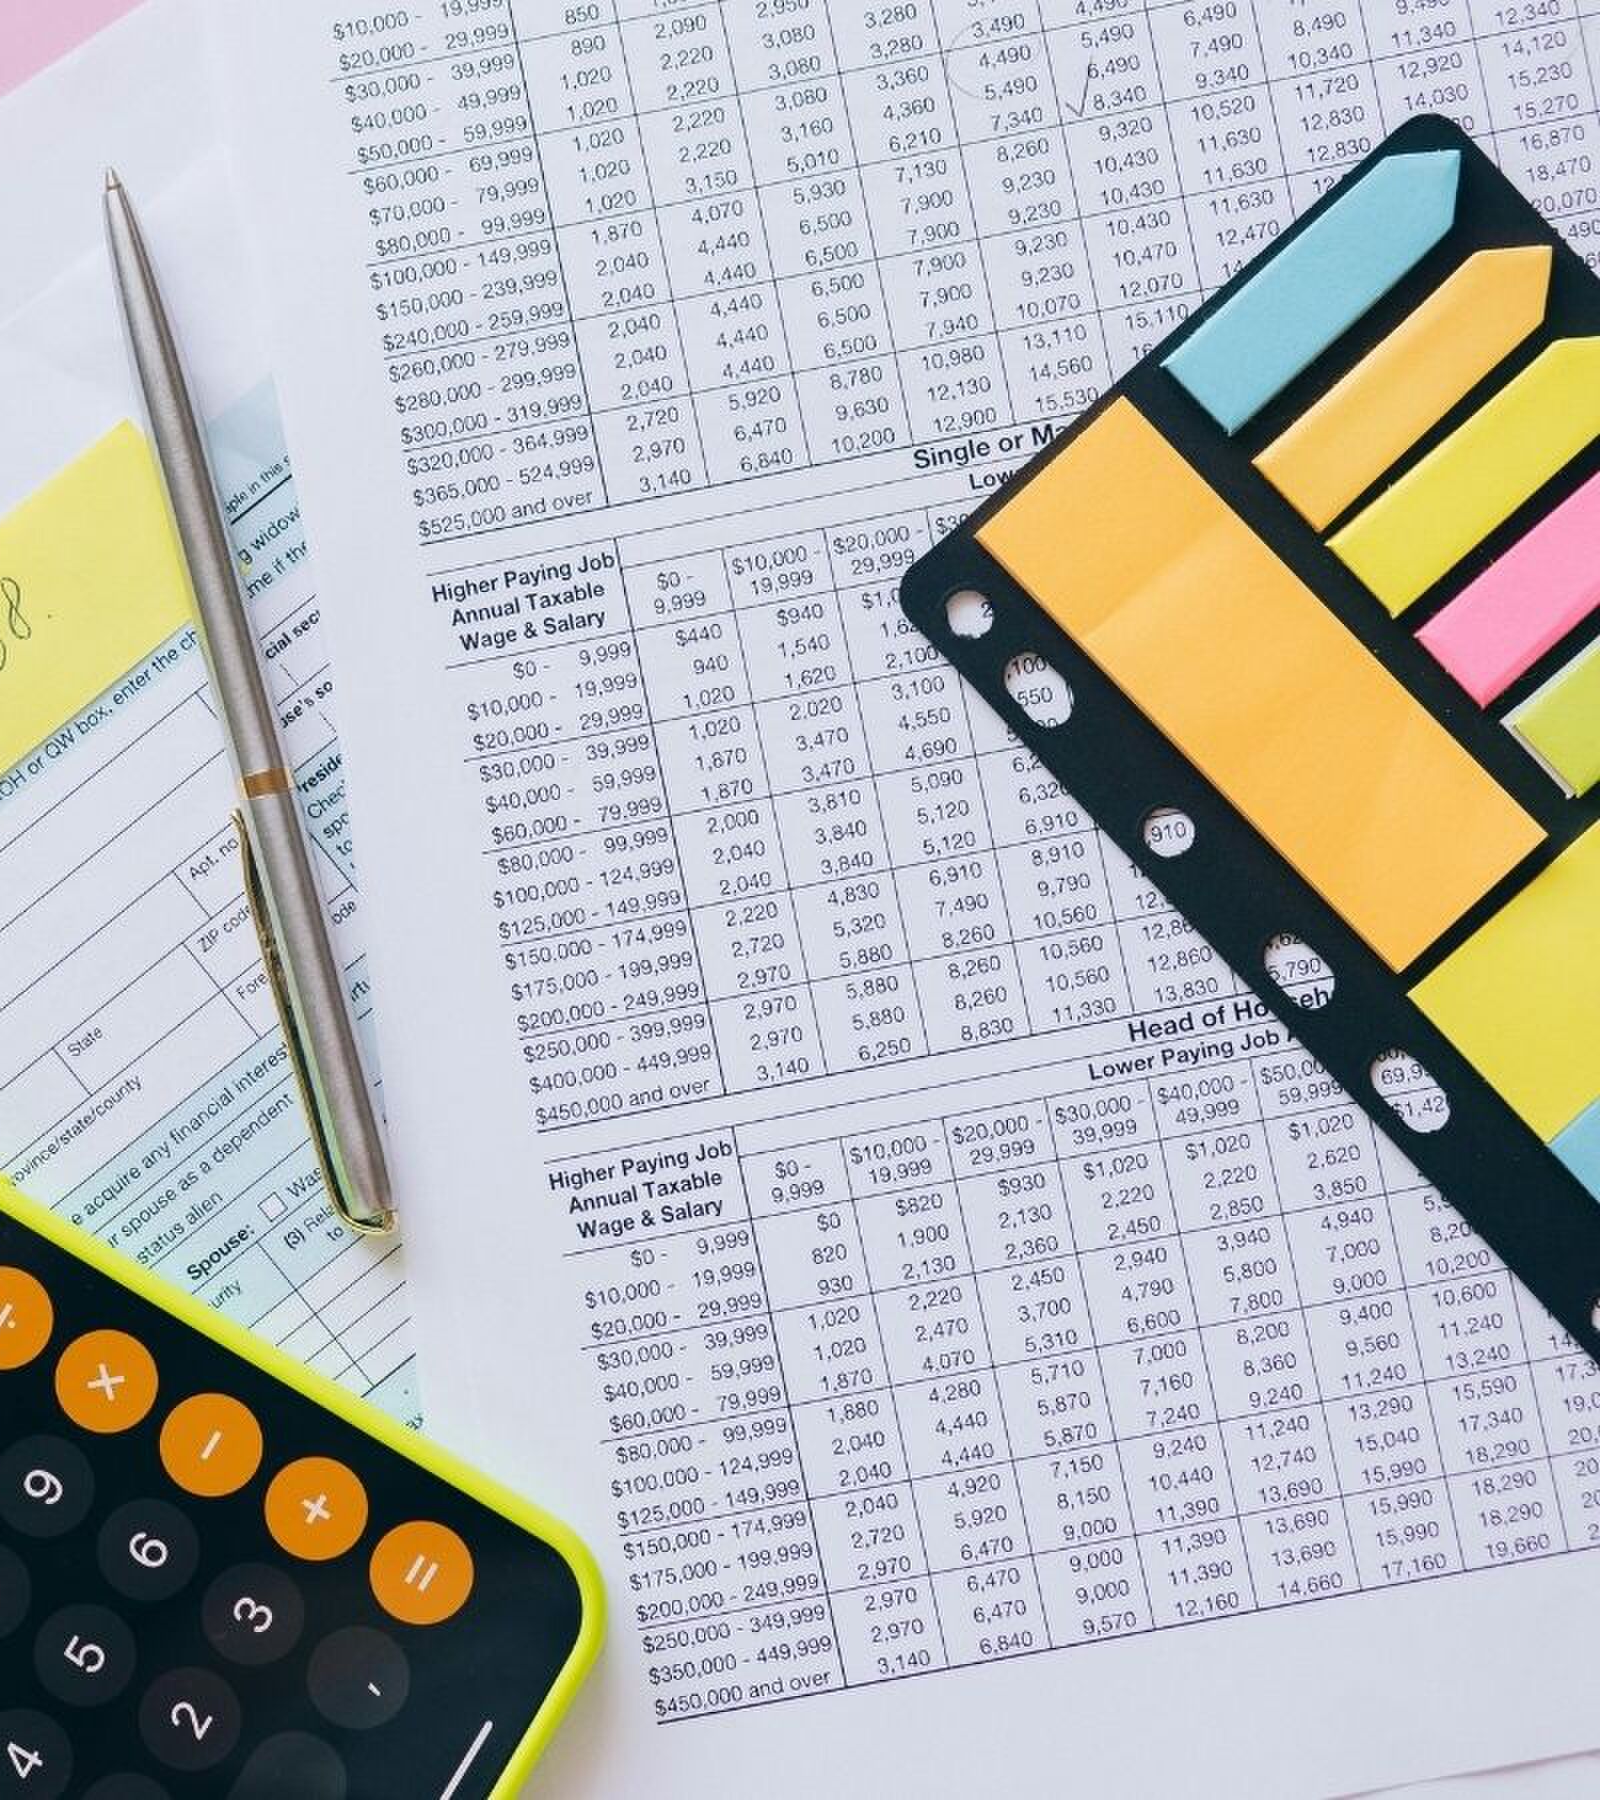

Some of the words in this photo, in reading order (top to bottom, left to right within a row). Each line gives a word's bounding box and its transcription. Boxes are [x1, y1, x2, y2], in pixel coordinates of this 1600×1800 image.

[584, 188, 638, 216] 1,020
[989, 105, 1044, 133] 7,340
[1390, 20, 1458, 49] 11,340
[1493, 0, 1561, 27] 12,340
[912, 437, 994, 471] Single
[991, 428, 1032, 465] or
[259, 463, 285, 484] this
[416, 504, 508, 539] $525,000
[510, 496, 549, 520] and
[551, 490, 593, 512] over
[638, 467, 694, 495] 3,140
[738, 446, 794, 474] 6,840
[830, 426, 896, 455] 10,200
[931, 406, 998, 438] 12,900
[430, 576, 500, 604] Higher
[502, 561, 576, 590] Paying
[576, 547, 616, 576] Job
[451, 595, 522, 628] Annual
[523, 580, 606, 612] Taxable
[457, 630, 508, 652] Wage
[511, 621, 532, 644] &
[527, 610, 606, 640] Salary
[26, 757, 46, 778] or
[44, 729, 77, 761] QW
[112, 668, 153, 706] enter
[151, 647, 181, 677] the
[188, 849, 221, 881] Apt.
[196, 927, 220, 954] ZIP
[66, 1025, 104, 1059] State
[1124, 1010, 1196, 1044] Head
[1196, 1002, 1227, 1030] of
[533, 1092, 630, 1128] $450,000
[628, 1084, 665, 1108] and
[668, 1078, 711, 1101] over
[755, 1056, 812, 1083] 3,140
[856, 1036, 912, 1066] 6,250
[959, 1016, 1015, 1046] 8,830
[1051, 996, 1118, 1028] 11,330
[1152, 976, 1221, 1005] 13,830
[1086, 1057, 1148, 1082] Lower
[1147, 1040, 1236, 1071] Paying
[1239, 1024, 1282, 1053] Job
[85, 1164, 143, 1218] acquire
[140, 1140, 174, 1171] any
[168, 1088, 237, 1149] financial
[120, 1187, 179, 1240] spouse
[175, 1169, 200, 1193] as
[197, 1158, 213, 1176] a
[210, 1090, 296, 1165] dependent
[547, 1164, 616, 1192] Higher
[619, 1150, 691, 1178] Paying
[694, 1138, 734, 1163] Job
[568, 1188, 634, 1216] Annual
[640, 1168, 724, 1200] Taxable
[134, 1220, 187, 1267] status
[183, 1190, 225, 1229] alien
[282, 1225, 307, 1253] (3)
[326, 1223, 345, 1245] to
[575, 1217, 630, 1240] Wage
[629, 1208, 652, 1232] &
[645, 1198, 724, 1228] Salary
[185, 1222, 258, 1282] Spouse:
[22, 1469, 64, 1506] 9
[128, 1531, 170, 1570] 6
[232, 1596, 274, 1634] 3
[652, 1684, 744, 1719] $450,000
[747, 1675, 788, 1699] and
[788, 1670, 832, 1692] over
[876, 1648, 932, 1676] 3,140
[978, 1628, 1034, 1657] 6,840
[1081, 1609, 1138, 1637] 9,570
[1173, 1590, 1240, 1619] 12,160
[1276, 1570, 1344, 1599] 14,660
[1380, 1551, 1448, 1581] 17,160
[1484, 1532, 1551, 1561] 19,660
[63, 1634, 107, 1675] 5
[169, 1699, 214, 1742] 2
[6, 1739, 45, 1781] 4
